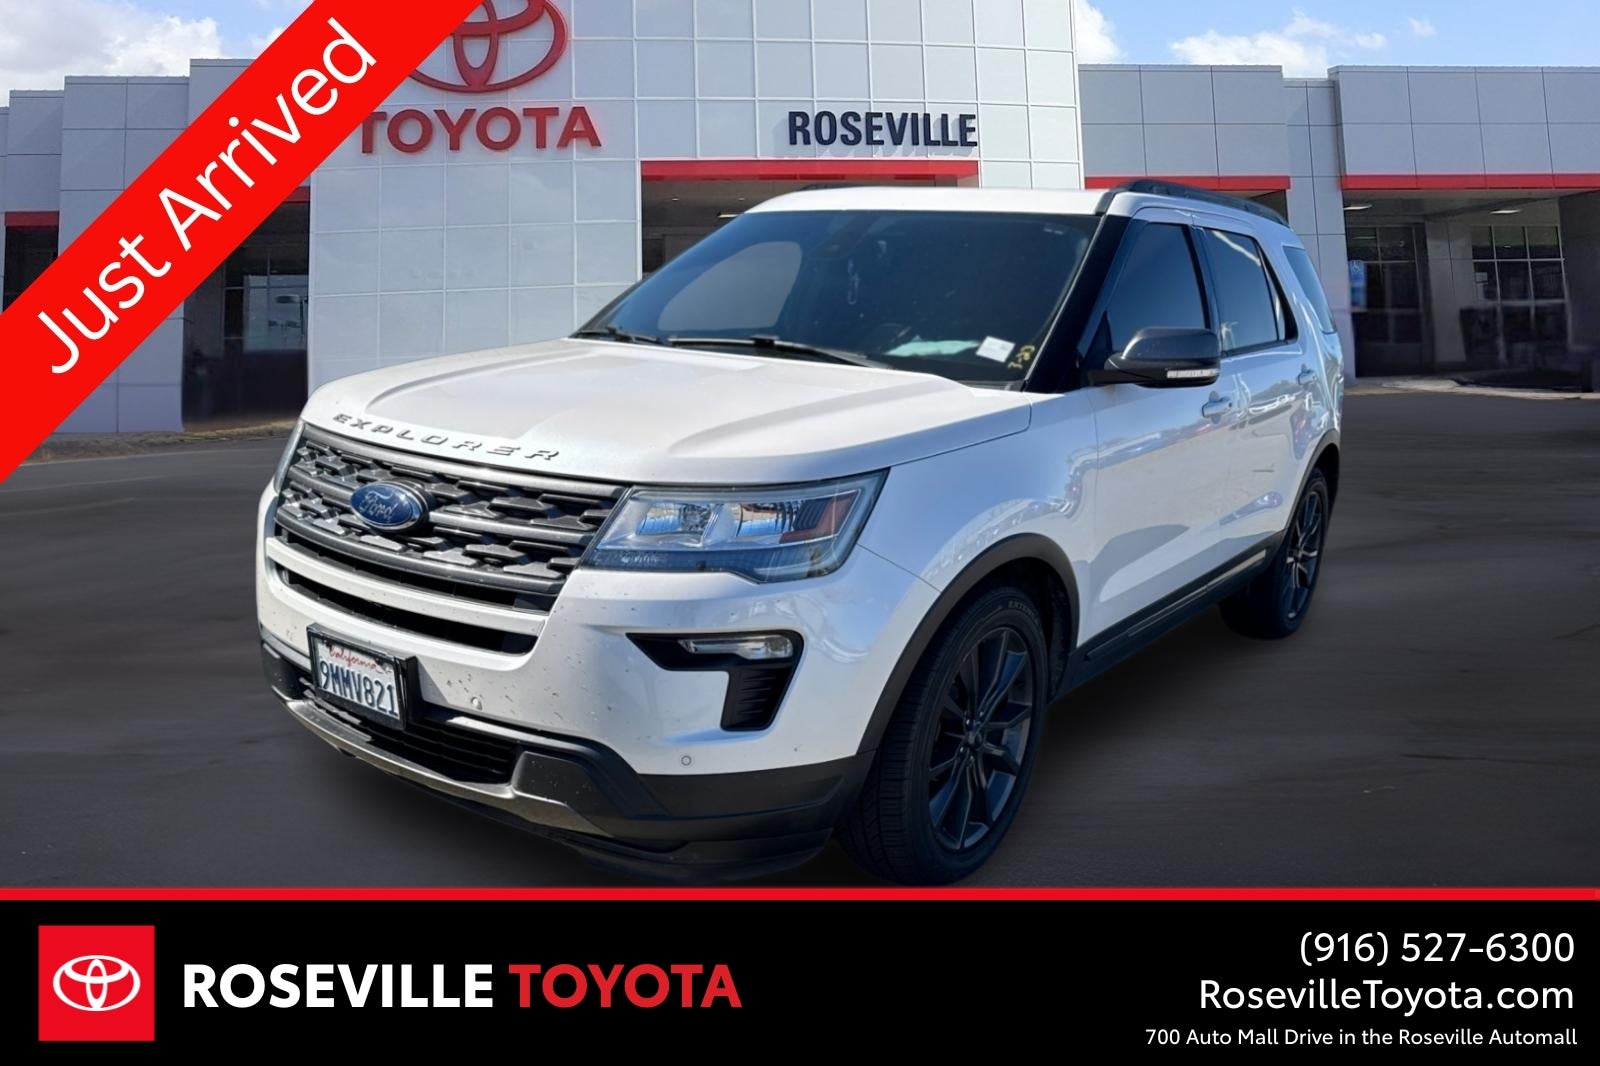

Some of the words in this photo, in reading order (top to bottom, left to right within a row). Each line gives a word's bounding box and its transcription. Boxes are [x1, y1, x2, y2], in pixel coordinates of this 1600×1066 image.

[361, 106, 602, 154] TOYOTA
[788, 111, 978, 147] ROSEVILLE
[333, 413, 560, 461] EXPLORER
[360, 490, 399, 519] Ford
[320, 661, 399, 717] 9MMV821
